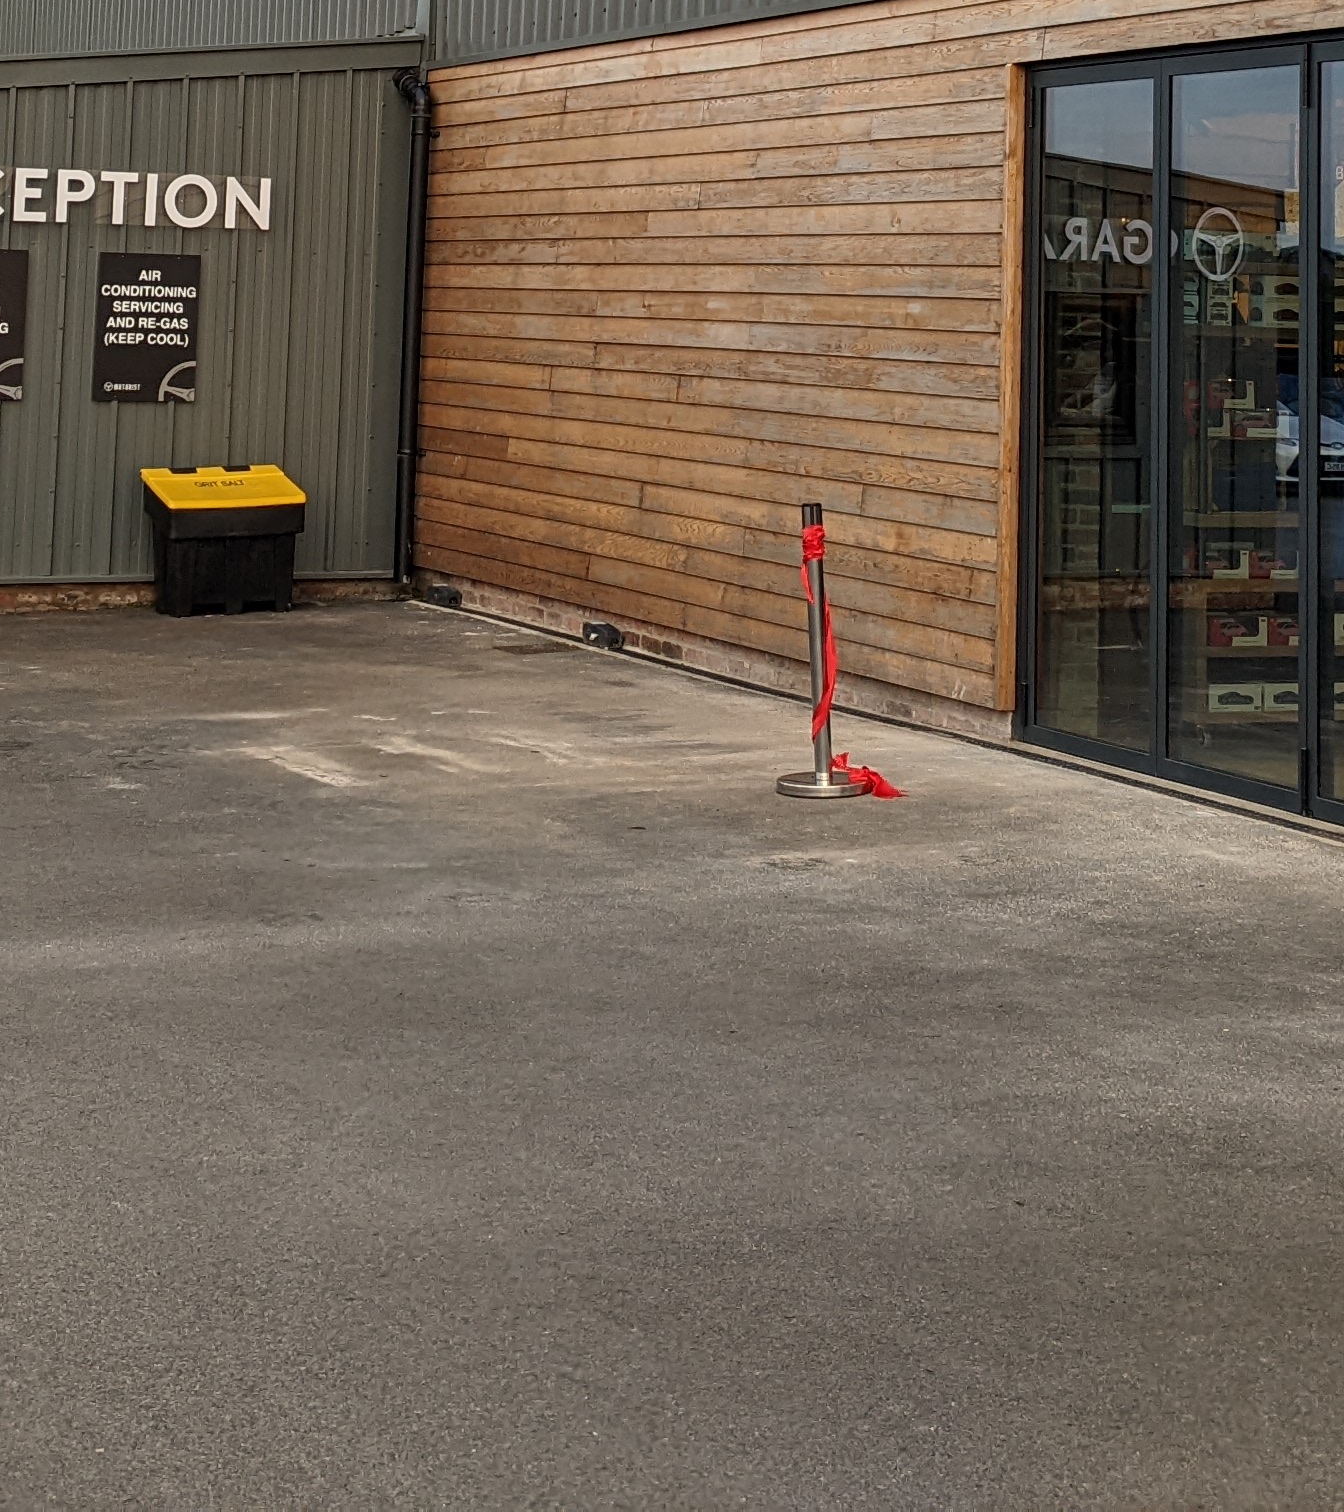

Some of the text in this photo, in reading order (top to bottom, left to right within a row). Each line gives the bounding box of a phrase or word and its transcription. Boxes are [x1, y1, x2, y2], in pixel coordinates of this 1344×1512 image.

[138, 269, 162, 282] AIR
[101, 284, 197, 298] CONDITIONING
[112, 300, 184, 314] SERVICING
[105, 316, 189, 330] AND RE-GAS
[103, 332, 189, 348] (KEEP COOL)
